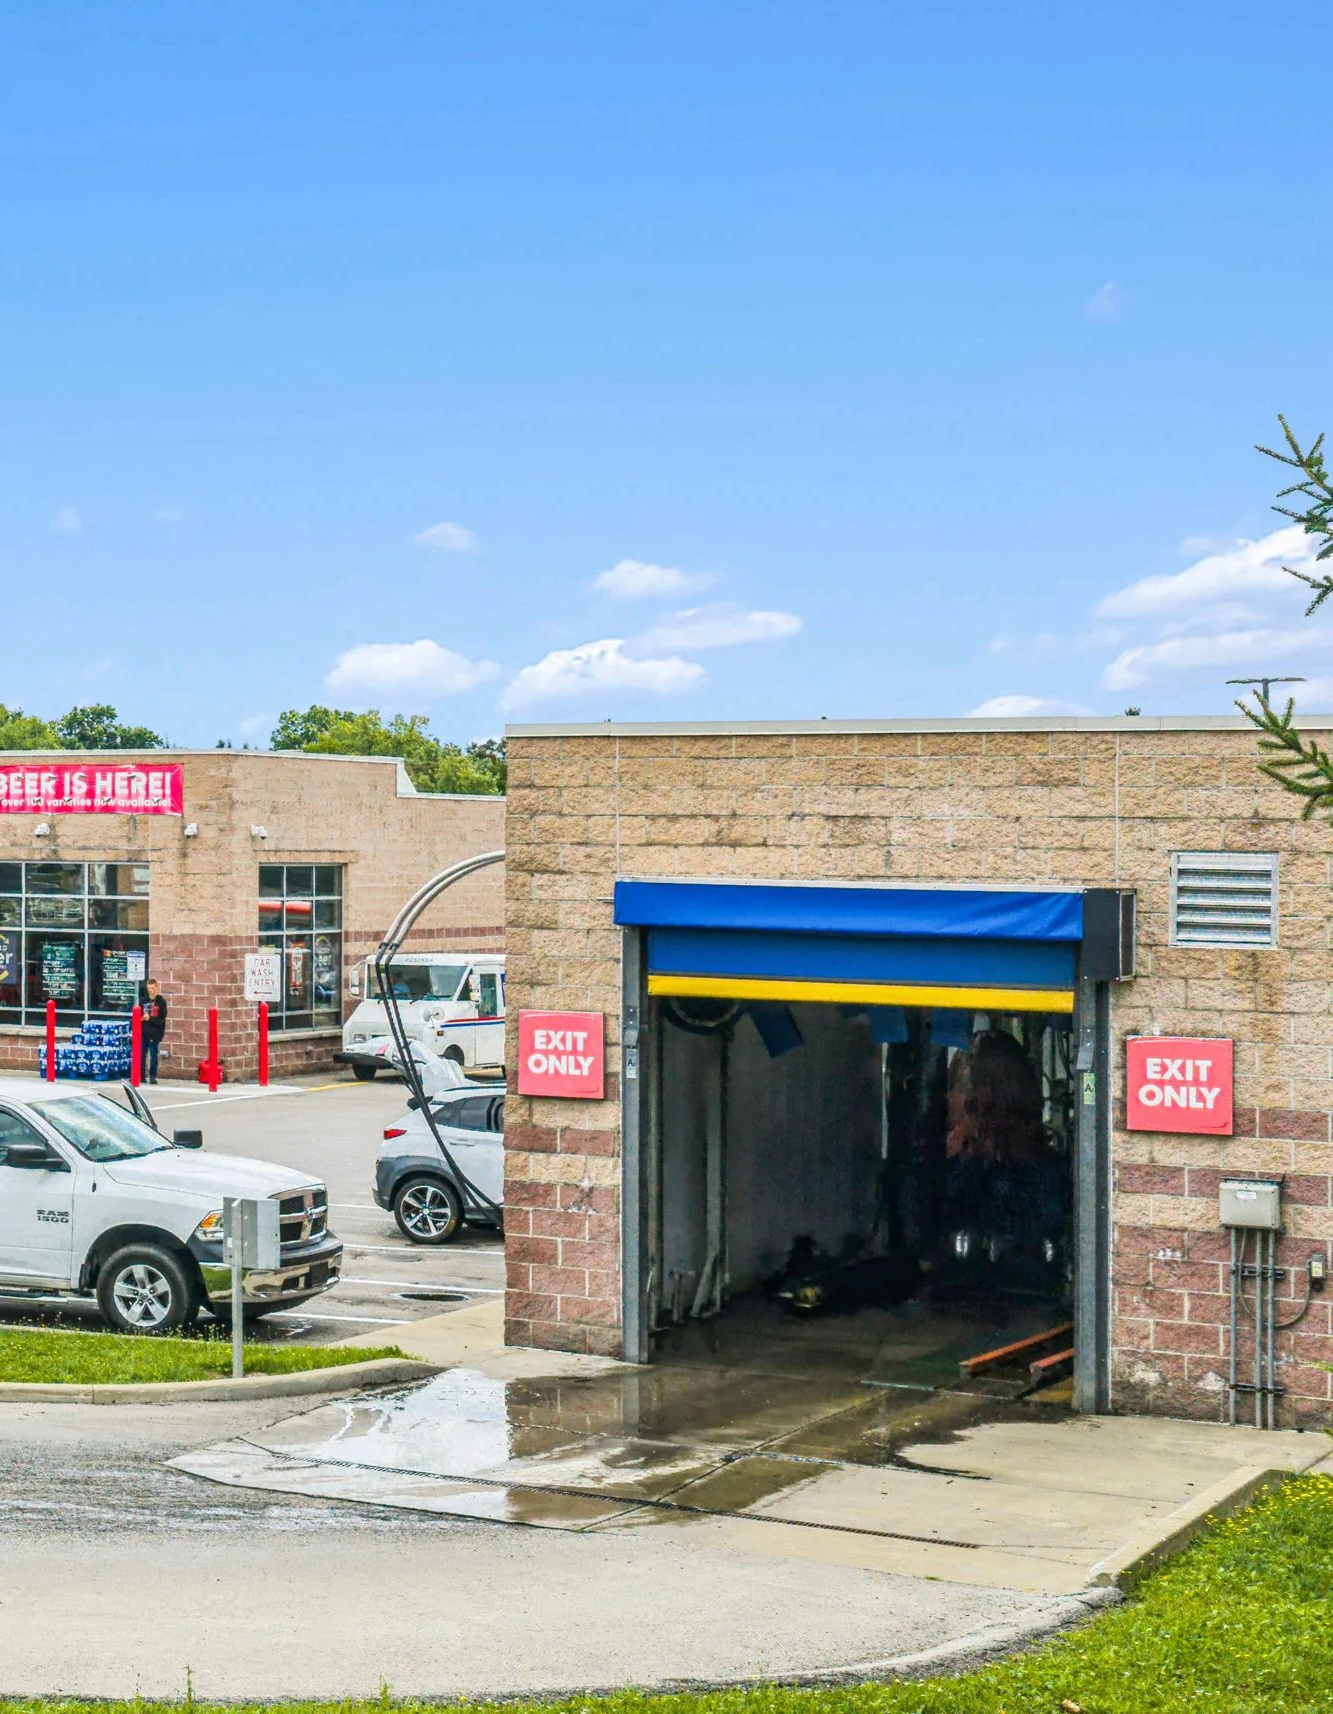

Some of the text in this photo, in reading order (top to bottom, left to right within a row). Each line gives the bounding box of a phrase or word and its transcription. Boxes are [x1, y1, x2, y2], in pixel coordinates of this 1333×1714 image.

[64, 772, 87, 795] IS
[96, 771, 171, 795] HERE!
[2, 798, 24, 807] over
[47, 797, 92, 807] varieties
[94, 798, 116, 807] now
[118, 797, 171, 807] available!
[253, 958, 270, 966] CAR
[251, 968, 273, 977] WASH
[248, 978, 275, 987] ENTRY
[534, 1030, 588, 1051] EXIT
[527, 1053, 595, 1076] ONLY
[1146, 1057, 1213, 1082] EXIT
[1138, 1084, 1221, 1109] ONLY
[37, 1209, 69, 1217] RAM
